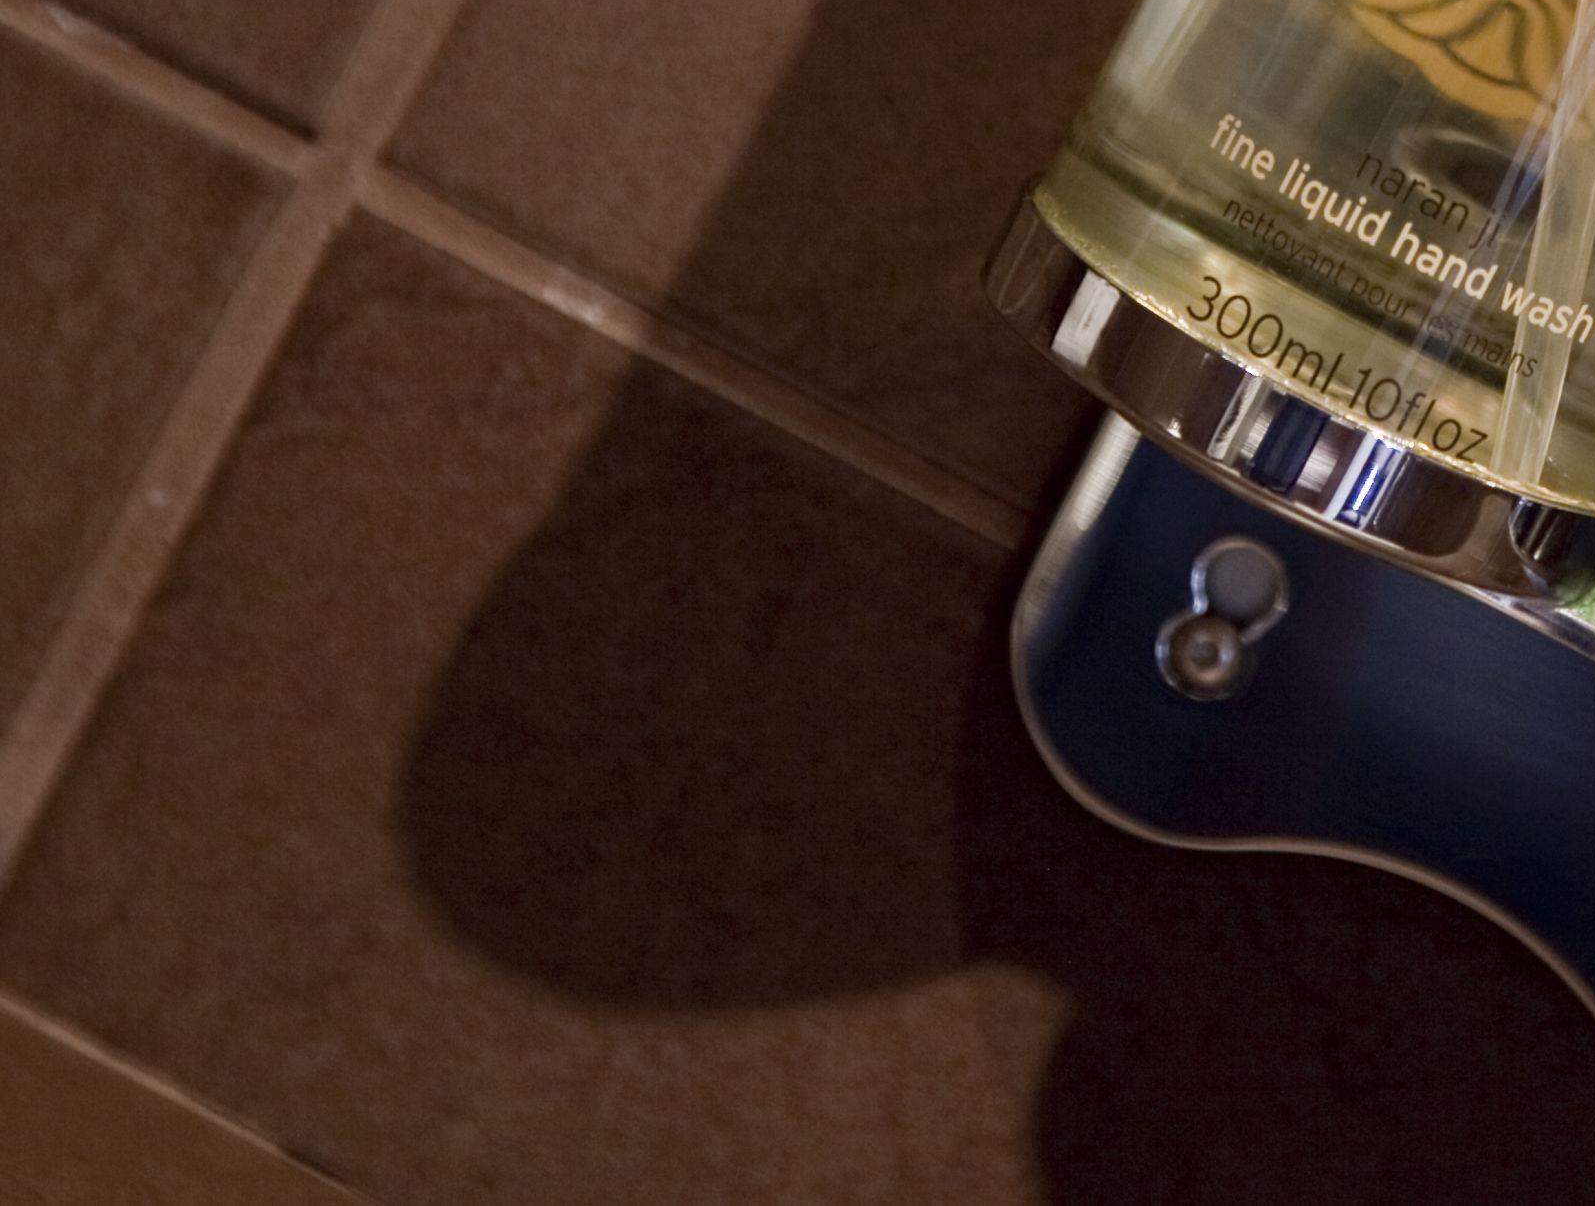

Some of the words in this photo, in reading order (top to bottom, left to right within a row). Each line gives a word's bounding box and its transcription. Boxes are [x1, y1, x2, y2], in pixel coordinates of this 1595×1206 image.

[1209, 114, 1275, 181] fine
[1278, 158, 1394, 246] liquid
[1391, 221, 1498, 300] hand
[1500, 279, 1595, 344] wash
[1356, 151, 1472, 233] naran
[1186, 276, 1344, 392] 300ml
[1431, 413, 1489, 463] oz
[1223, 197, 1348, 283] nettoyant
[1348, 274, 1415, 317] pour
[1462, 328, 1539, 378] mains
